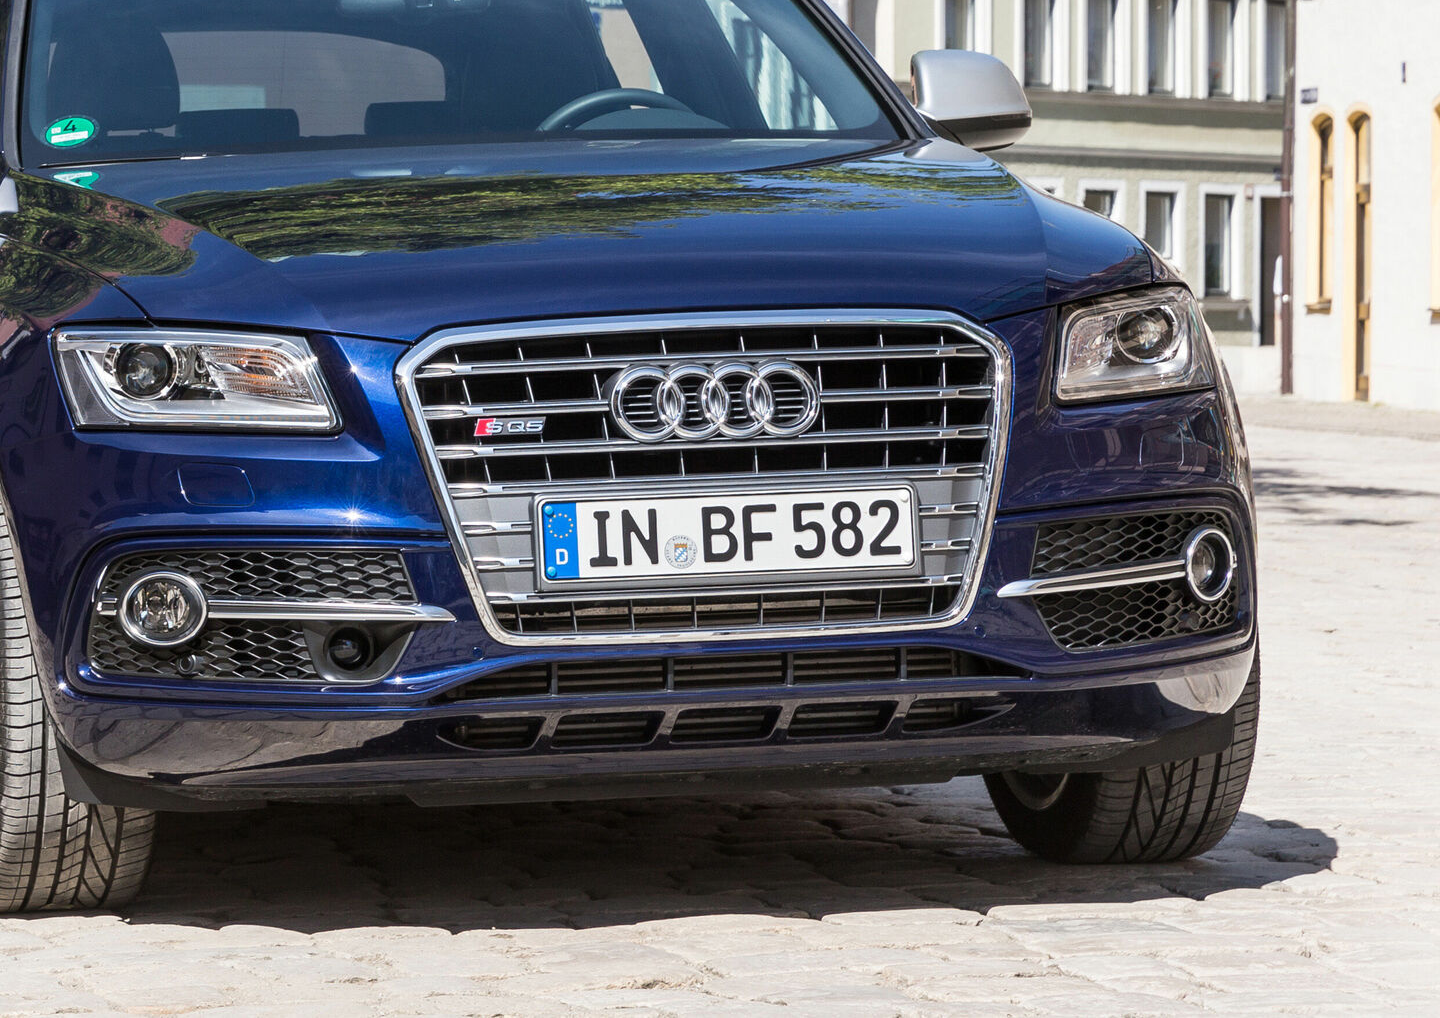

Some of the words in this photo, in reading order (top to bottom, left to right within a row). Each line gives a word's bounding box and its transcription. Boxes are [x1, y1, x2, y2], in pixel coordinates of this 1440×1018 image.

[62, 119, 78, 132] 4
[589, 508, 659, 568] IN
[701, 503, 777, 564] BF
[792, 498, 903, 560] 582
[555, 548, 569, 566] D
